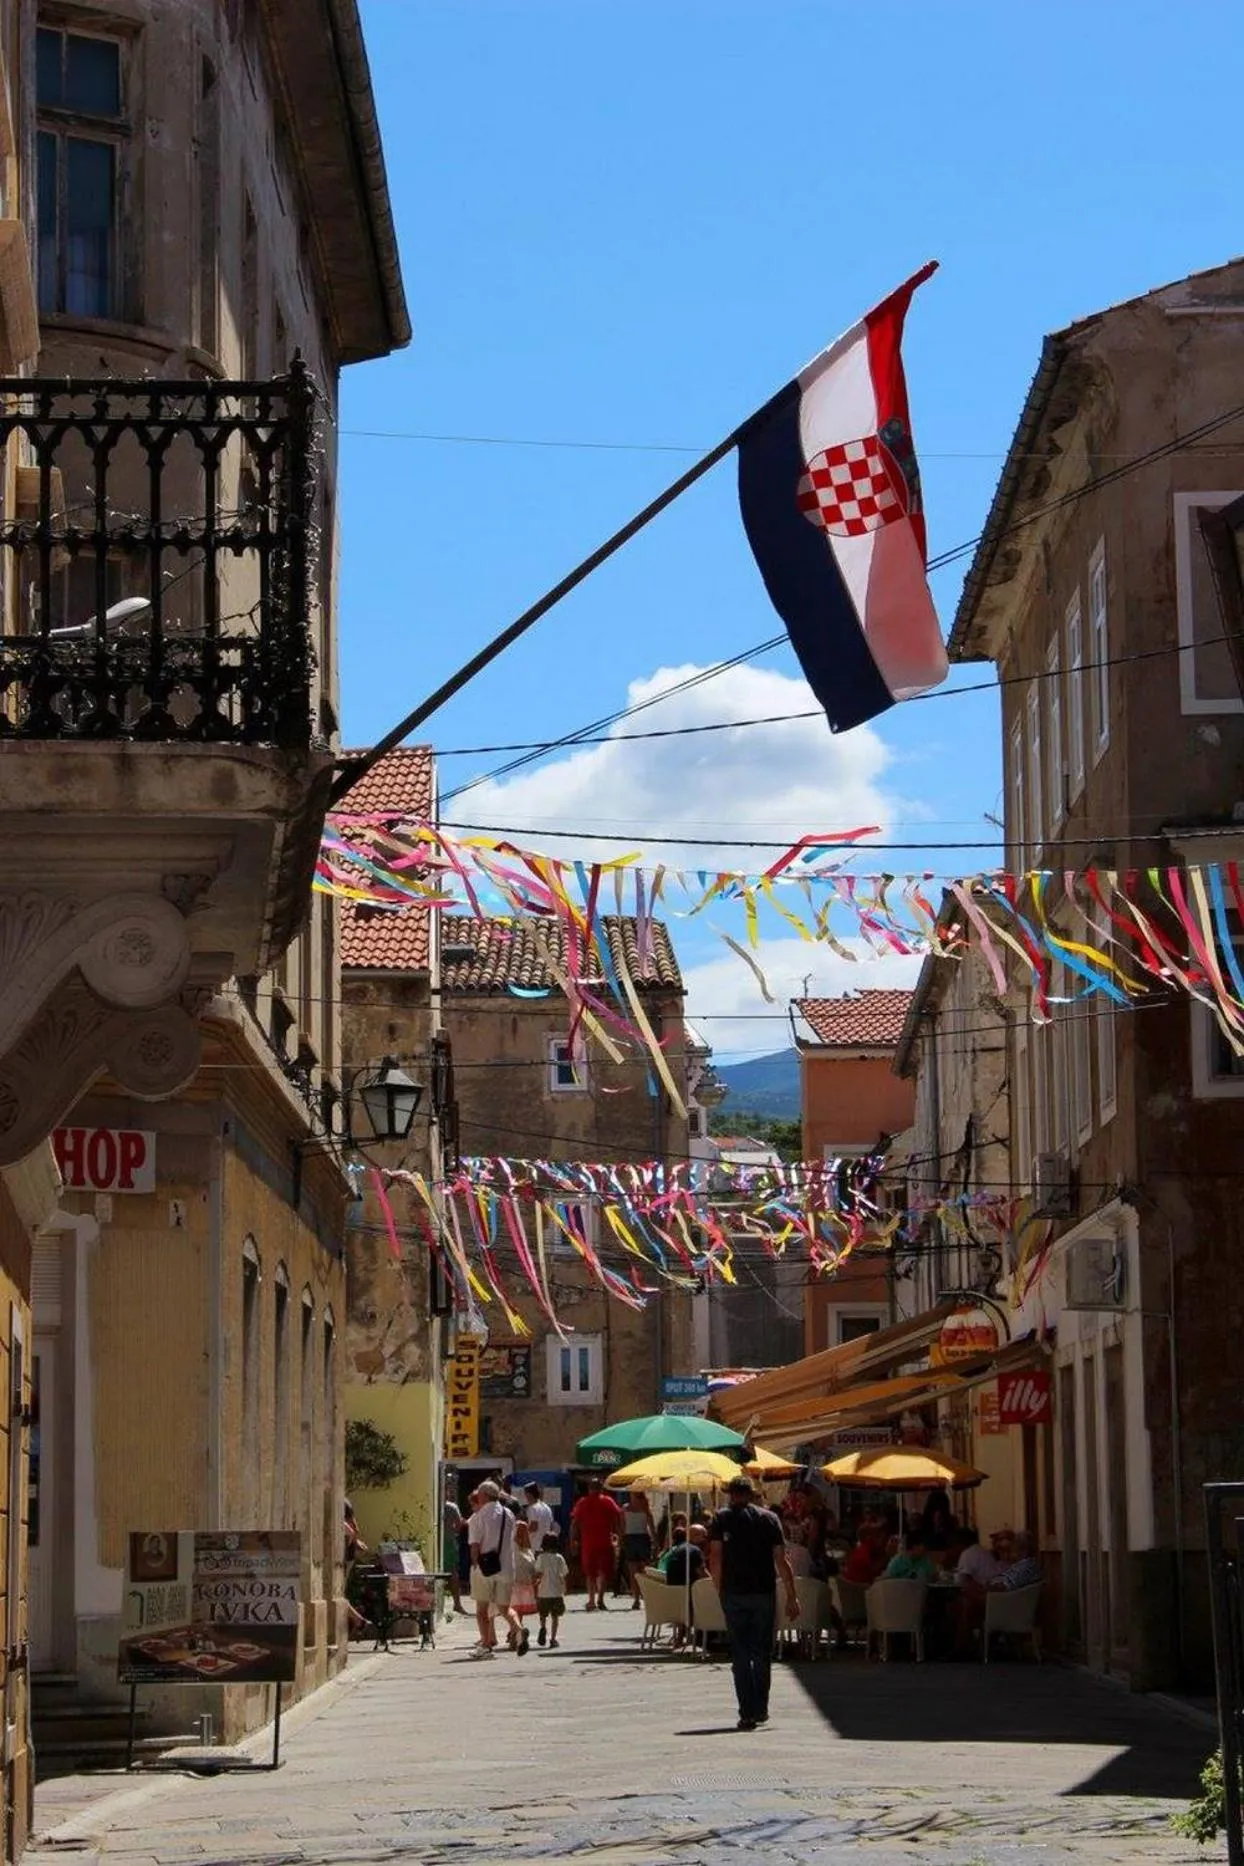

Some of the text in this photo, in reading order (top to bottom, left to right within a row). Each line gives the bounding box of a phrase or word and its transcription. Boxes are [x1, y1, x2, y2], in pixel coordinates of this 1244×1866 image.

[451, 1340, 477, 1457] SOUVENIRS
[1001, 1378, 1049, 1419] illy
[836, 1432, 890, 1444] SOUVENIRS
[194, 1582, 296, 1600] KONOBA
[209, 1602, 285, 1621] IVKA
